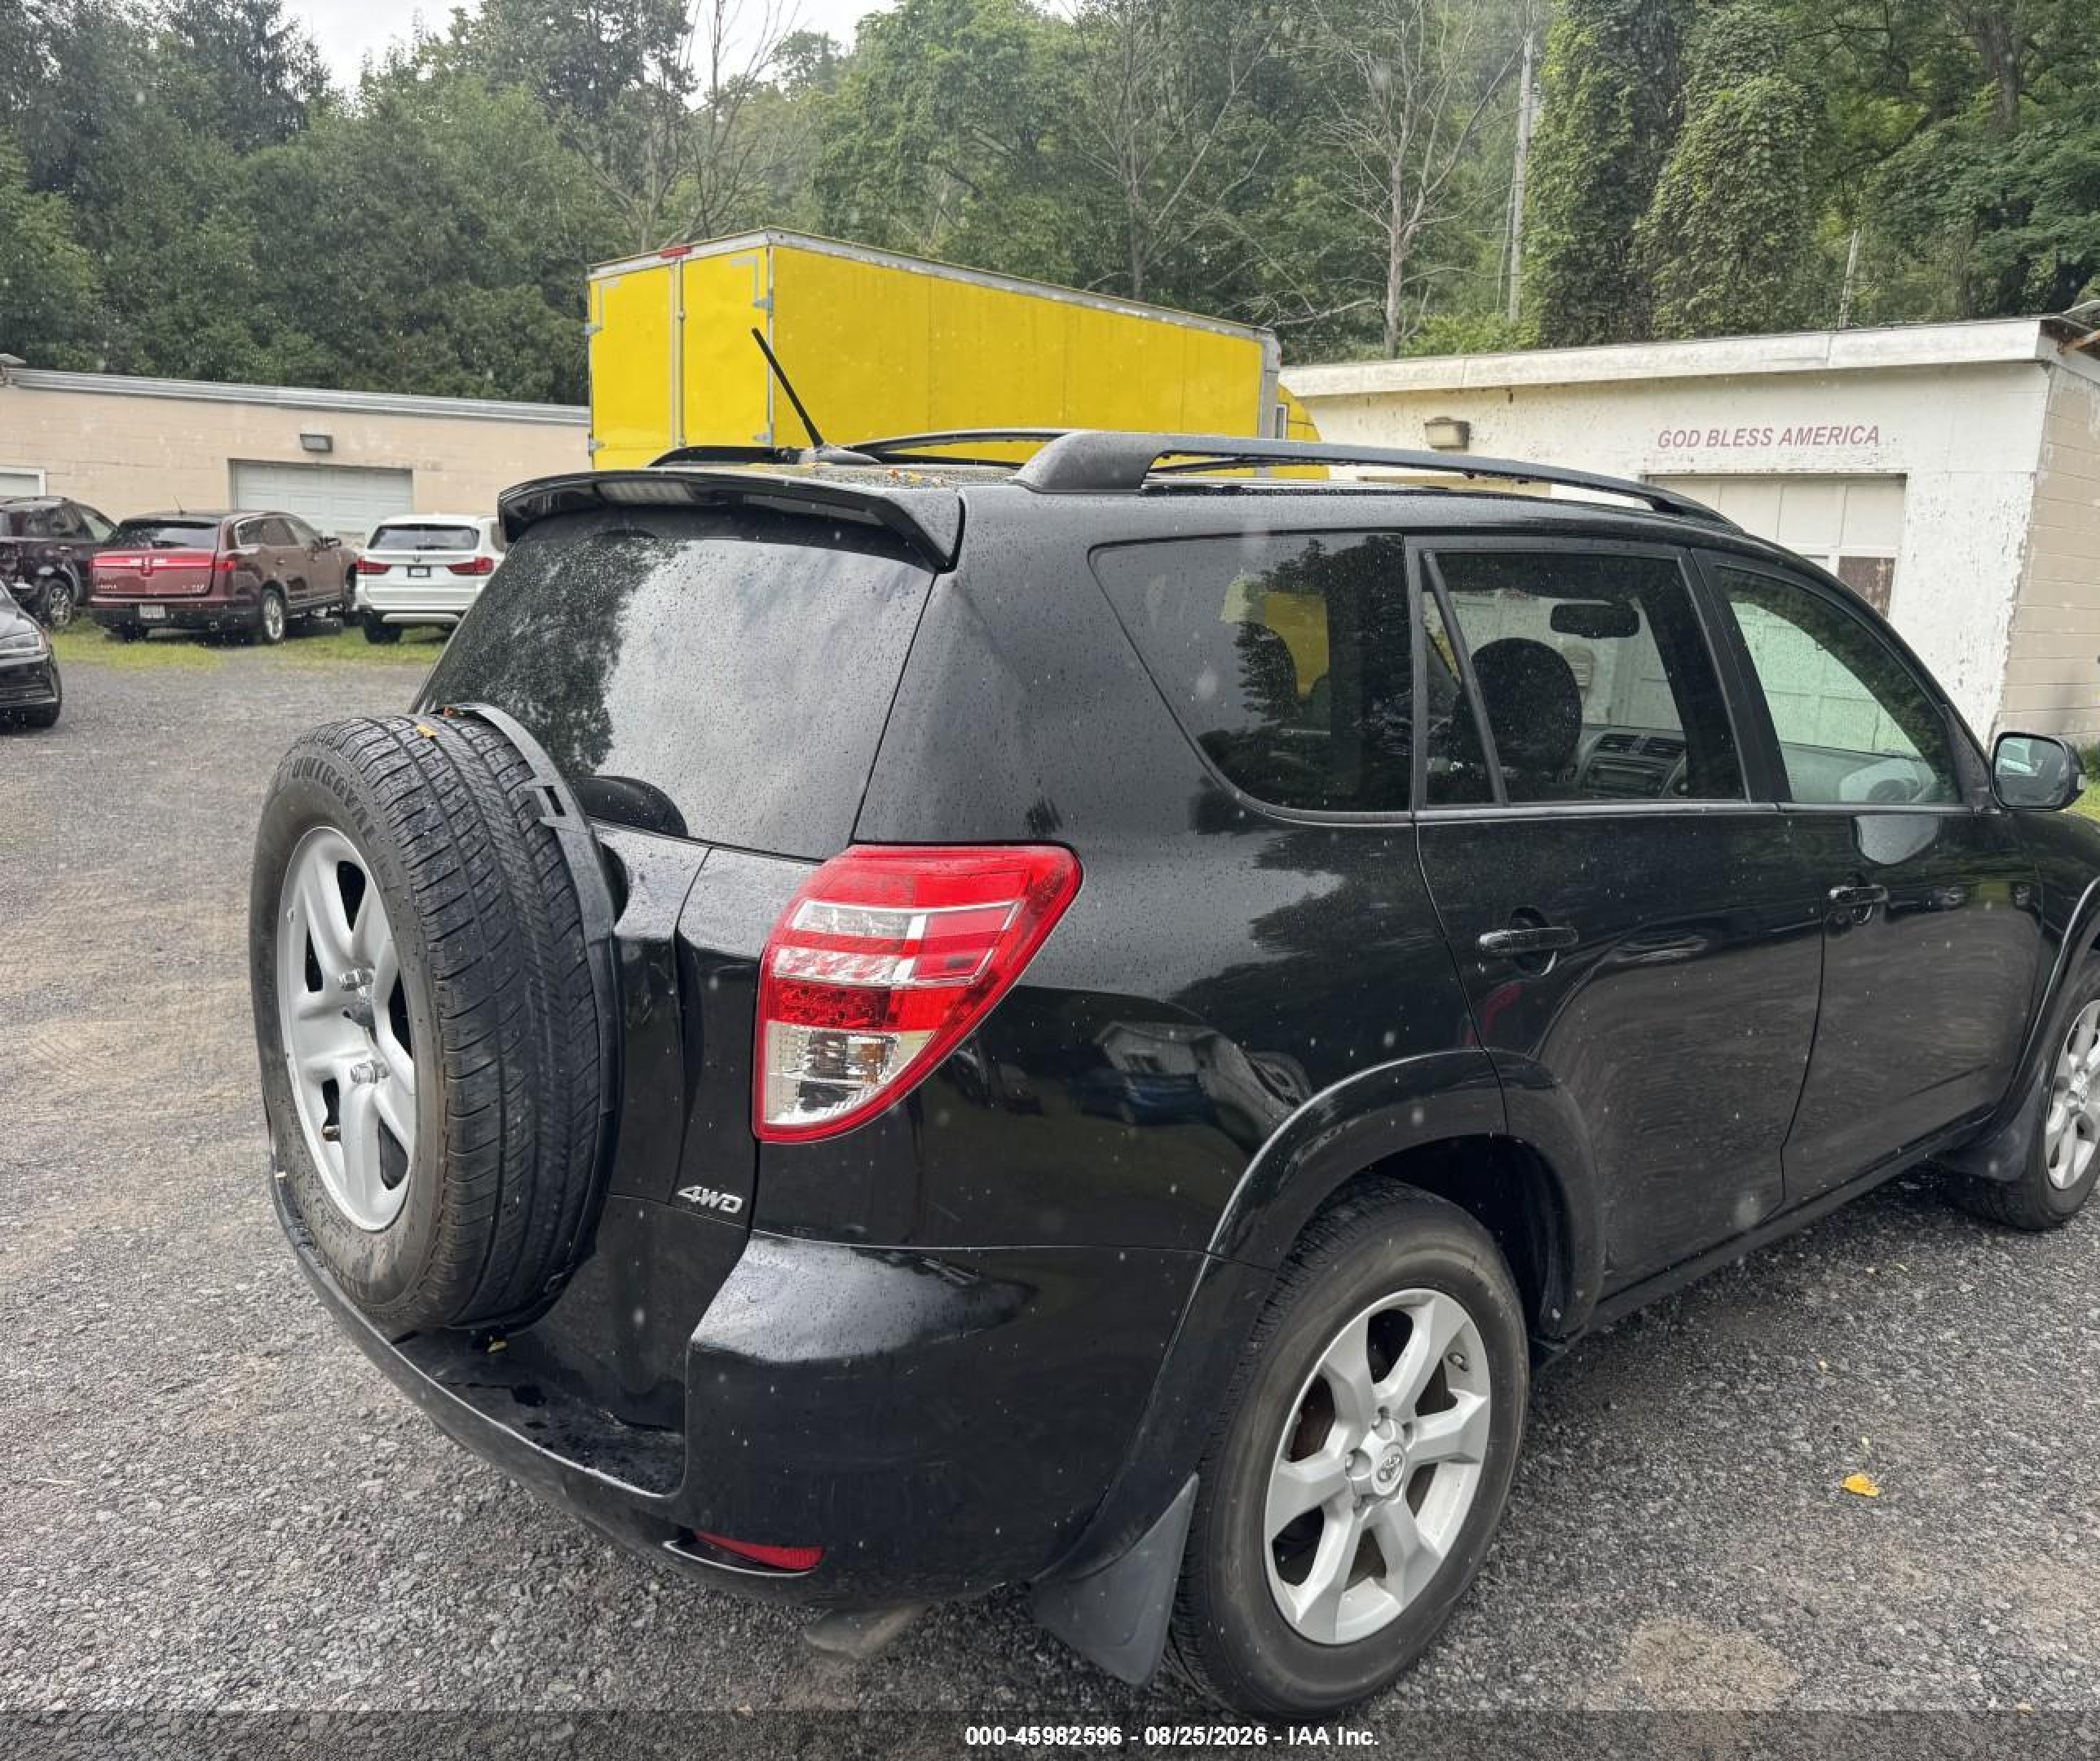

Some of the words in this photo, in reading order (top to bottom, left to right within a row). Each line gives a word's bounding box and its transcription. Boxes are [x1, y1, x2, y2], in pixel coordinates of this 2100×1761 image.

[1658, 429, 1701, 448] GOD
[1706, 427, 1775, 448] BLESS
[1778, 425, 1880, 447] AMERICA
[677, 1185, 743, 1213] 4WD
